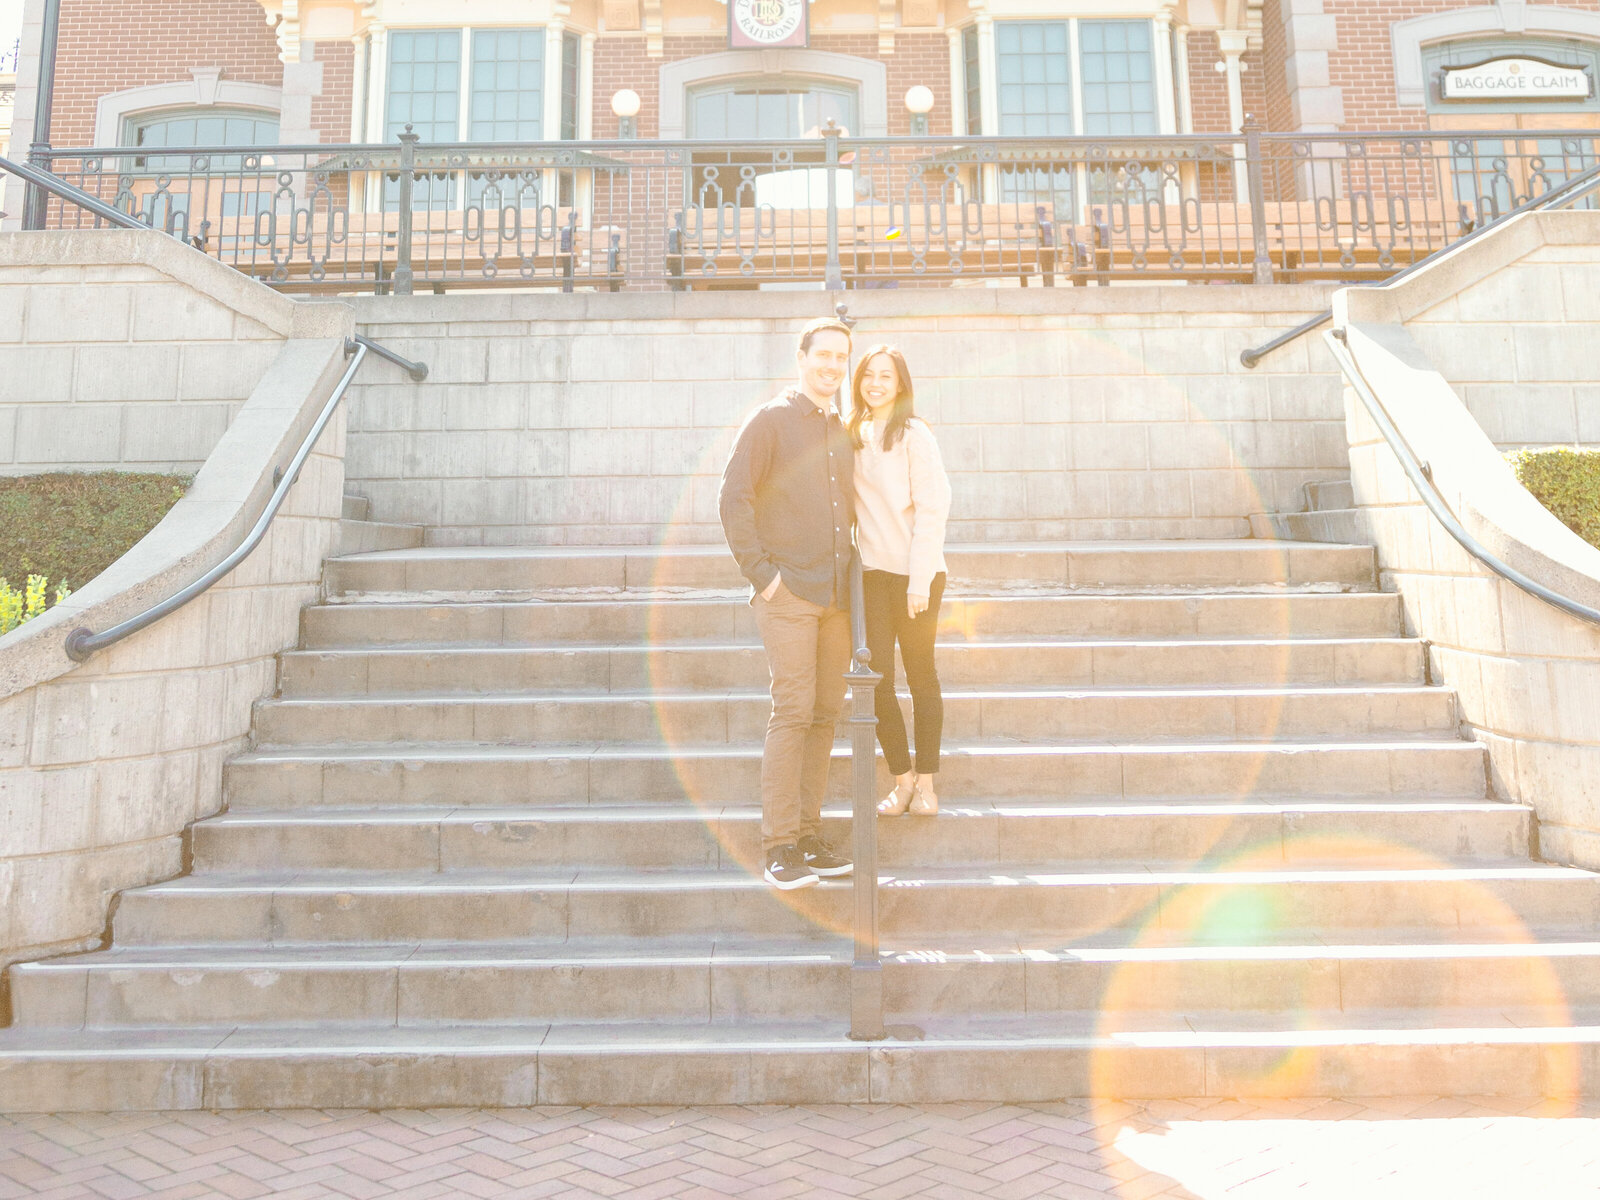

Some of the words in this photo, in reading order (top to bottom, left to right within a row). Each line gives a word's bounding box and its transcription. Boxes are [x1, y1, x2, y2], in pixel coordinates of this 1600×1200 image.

[741, 16, 795, 39] RAILROAD
[1455, 76, 1525, 88] BAGGAGE
[1533, 76, 1578, 87] CLAIM
